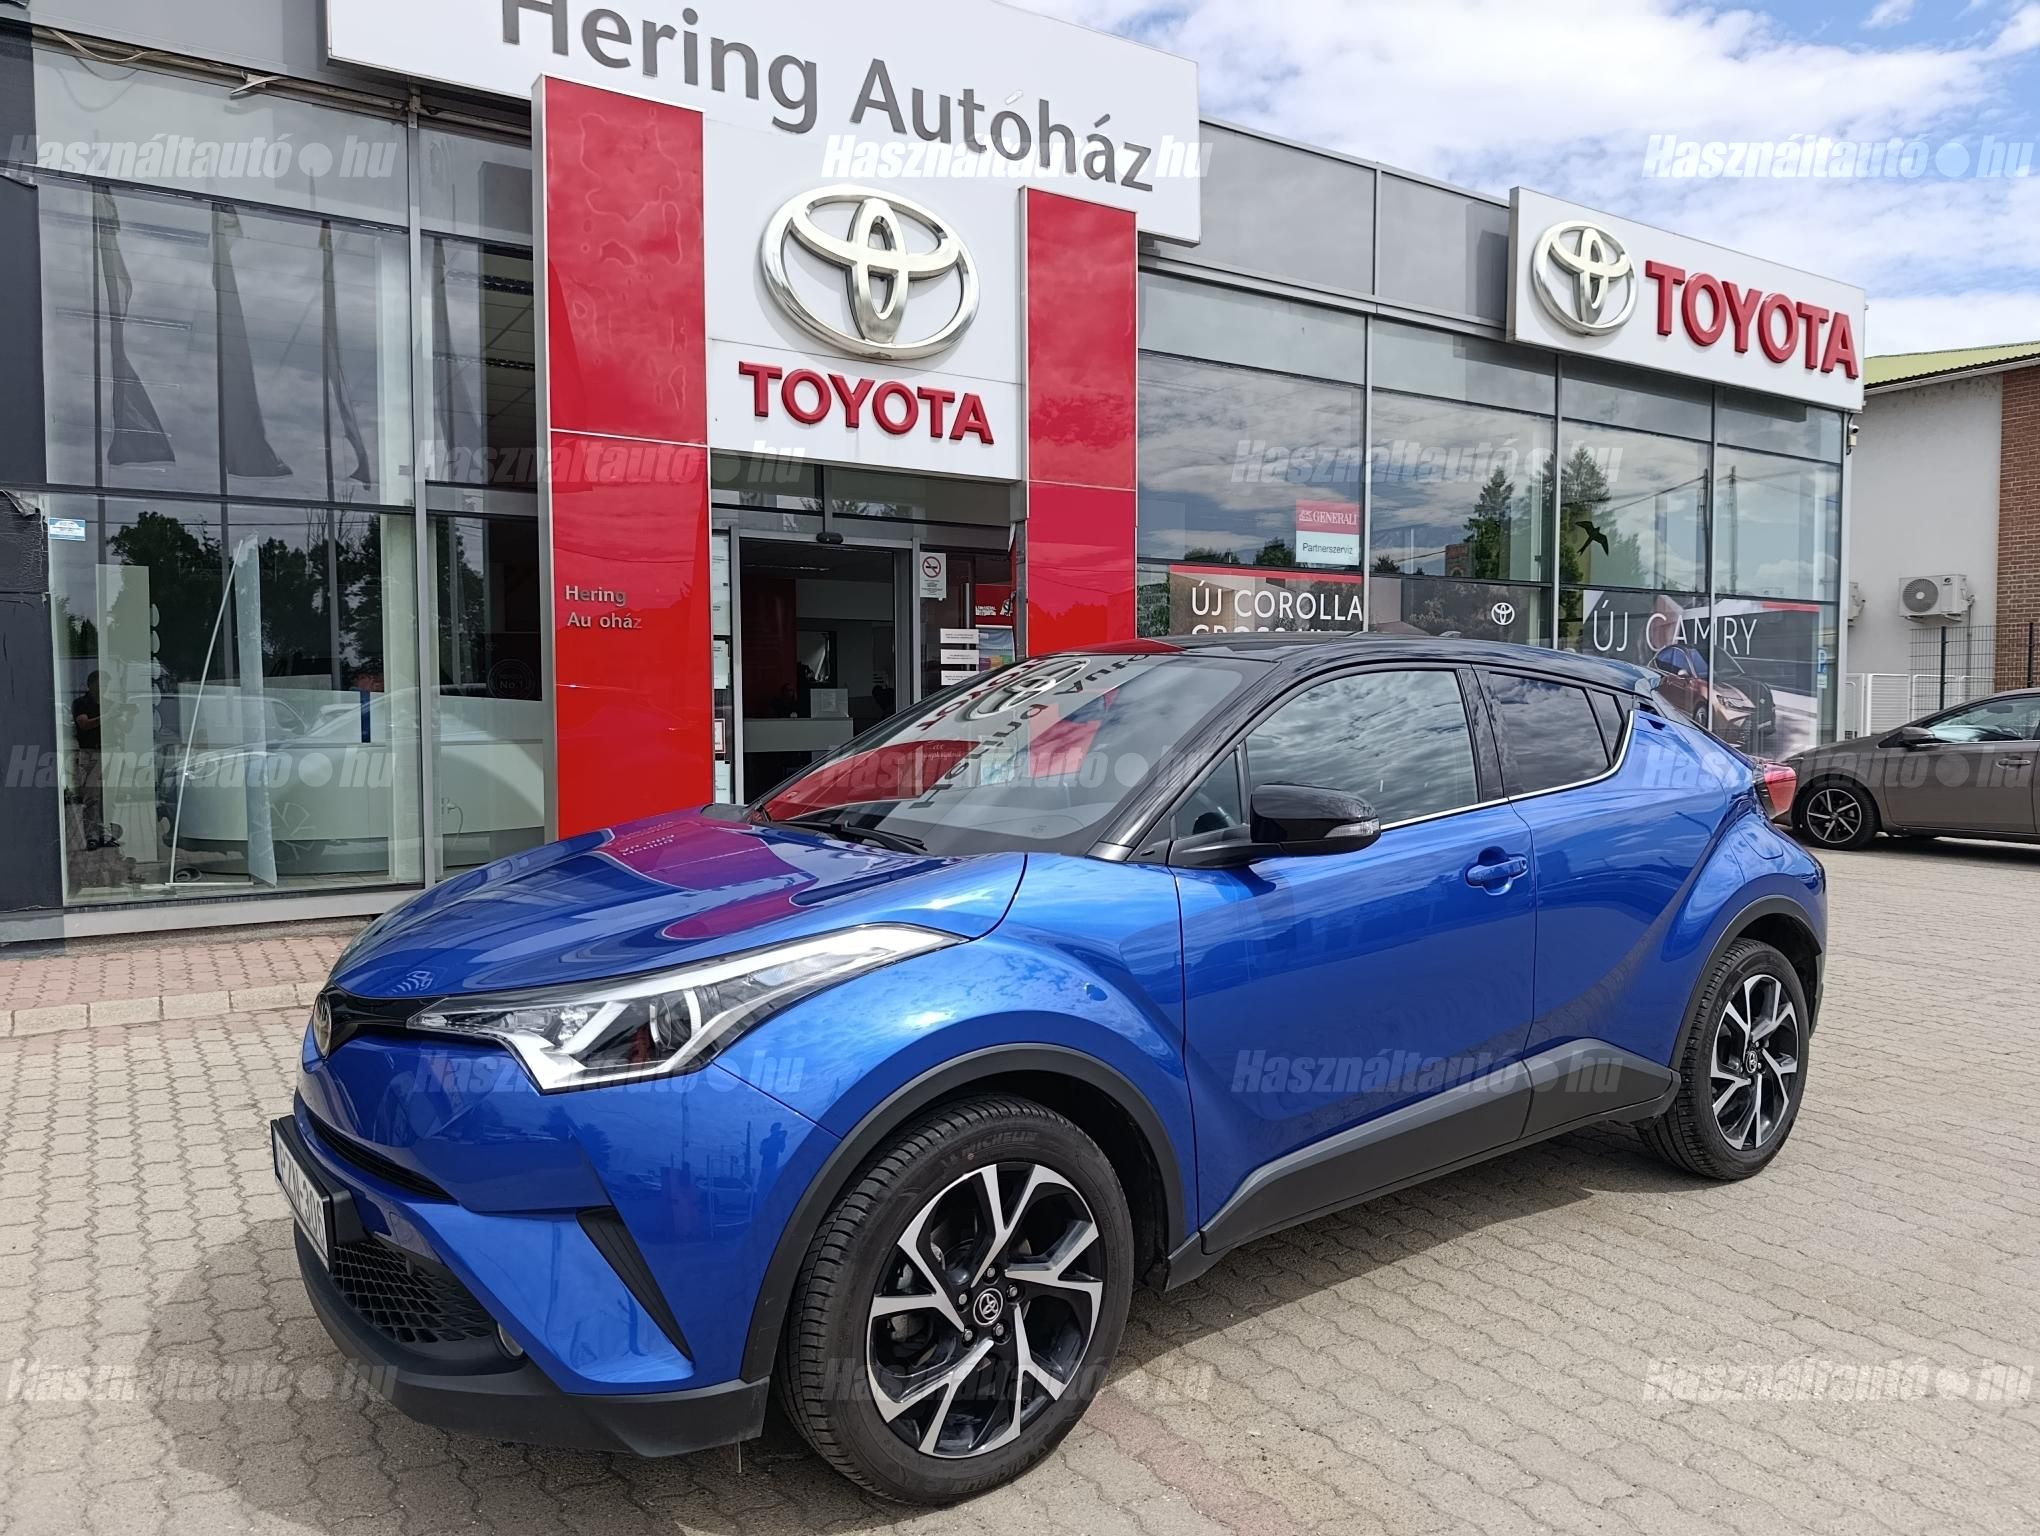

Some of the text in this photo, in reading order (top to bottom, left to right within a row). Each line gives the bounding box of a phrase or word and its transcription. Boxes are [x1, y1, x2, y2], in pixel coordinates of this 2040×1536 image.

[502, 0, 1153, 192] Hering Autóház
[1645, 259, 1859, 380] TOYOTA
[738, 360, 995, 445] TOYOTA
[1312, 510, 1358, 526] GENERALI
[565, 585, 626, 608] Hering
[1191, 579, 1363, 622] ÚJ COROLLA
[1593, 599, 1758, 656] ÚJ CAMRY
